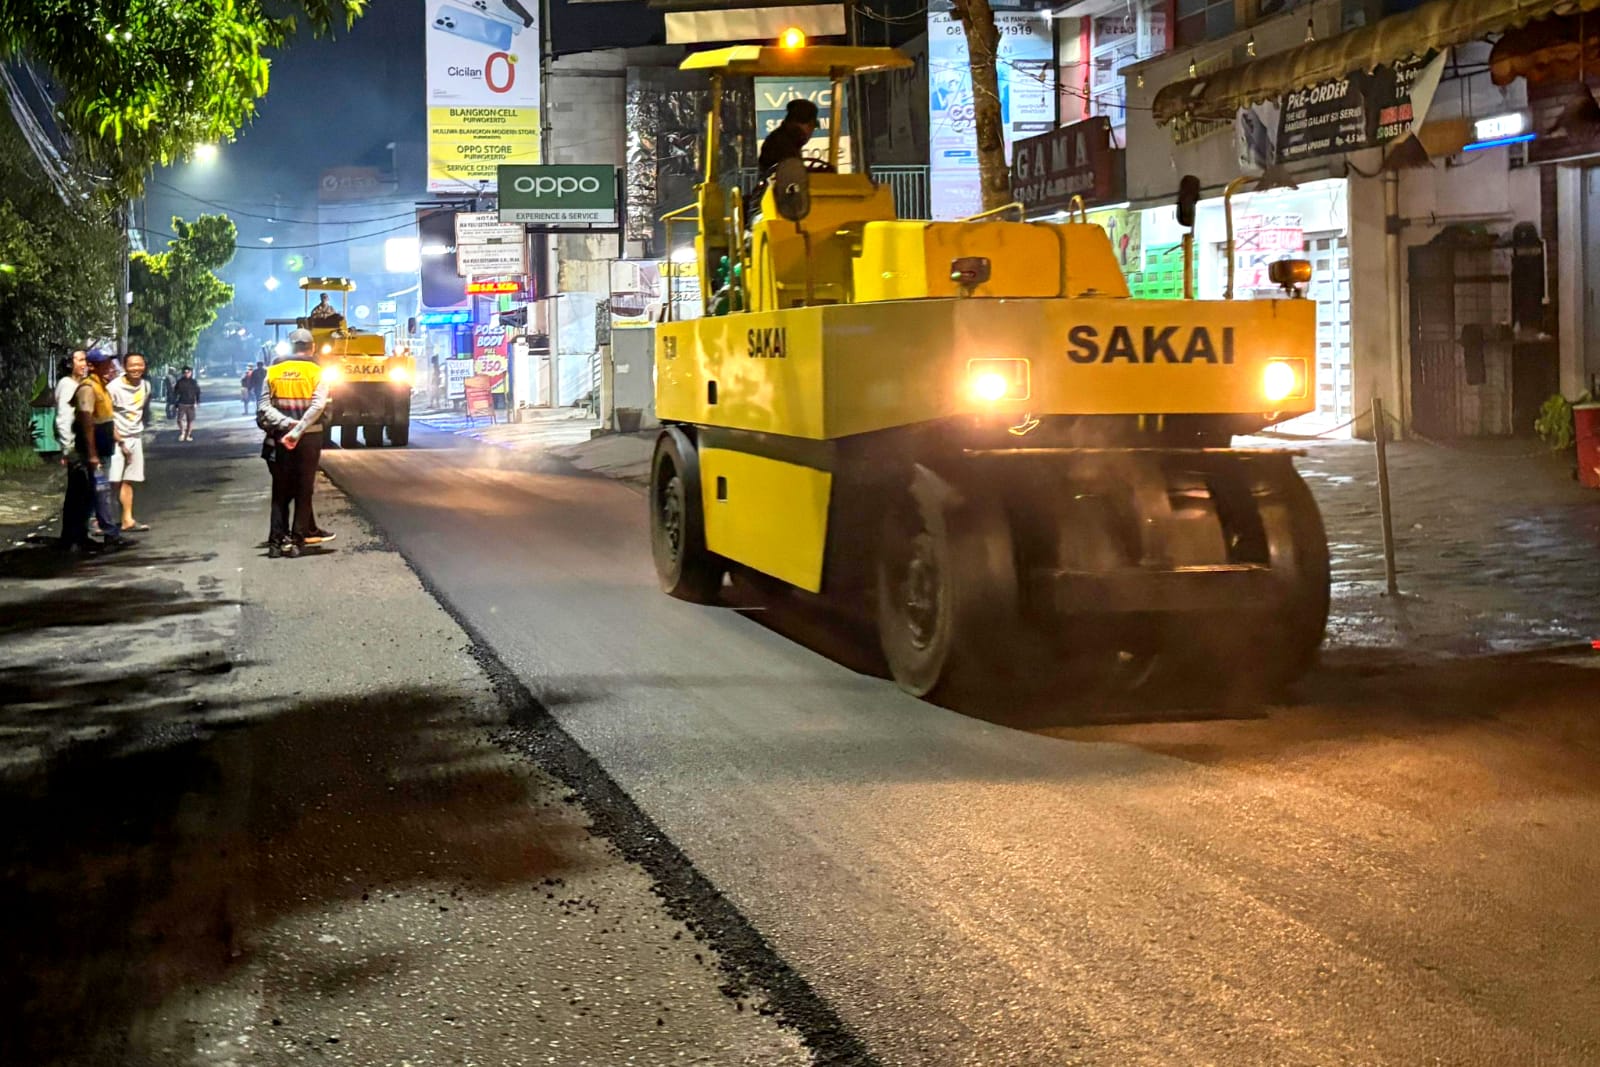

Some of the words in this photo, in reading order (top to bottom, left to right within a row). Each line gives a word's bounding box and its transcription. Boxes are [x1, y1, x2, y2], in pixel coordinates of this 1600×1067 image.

[447, 66, 482, 77] Cicilan
[485, 52, 515, 93] 0
[764, 86, 832, 107] vivo
[1287, 80, 1349, 110] PRE-ORDER
[449, 108, 497, 117] BLANGKON
[498, 108, 518, 117] CELL
[456, 145, 482, 154] OPPO
[483, 145, 513, 154] STORE
[1016, 132, 1089, 179] GAMA
[447, 164, 474, 172] SERVICE
[514, 176, 600, 198] oppo
[477, 335, 505, 347] BODY
[747, 327, 787, 358] SAKAI
[1067, 325, 1235, 364] SAKAI
[345, 364, 385, 374] SAKAI
